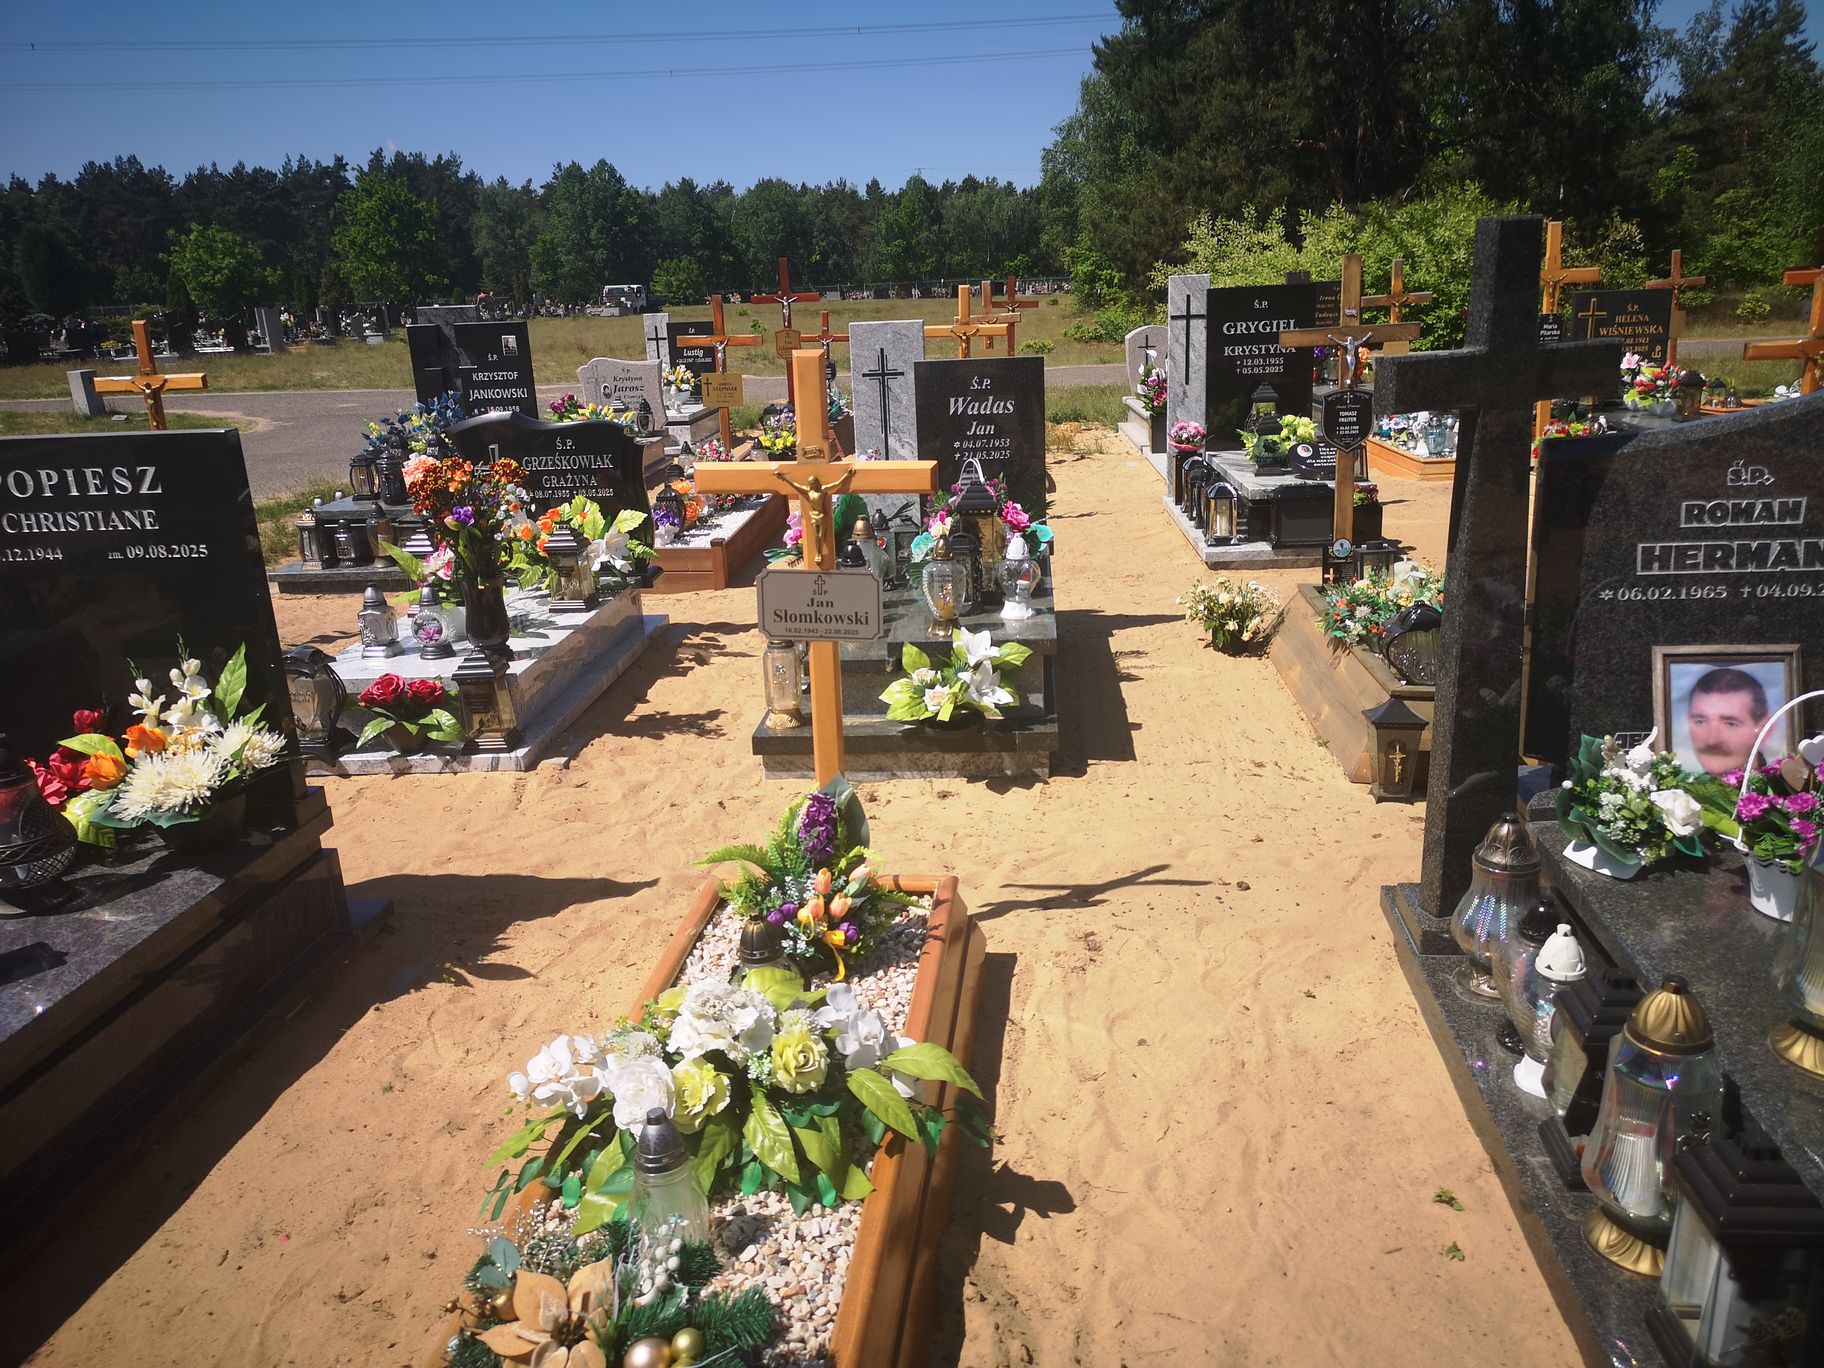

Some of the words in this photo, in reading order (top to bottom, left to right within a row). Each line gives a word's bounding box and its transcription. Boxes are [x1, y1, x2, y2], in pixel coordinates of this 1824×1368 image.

[1253, 299, 1269, 309] Ś.P.
[1615, 315, 1649, 323] HELENA
[1222, 319, 1299, 335] GRYGIEL
[1599, 323, 1663, 336] WIŚNIEWSKA
[683, 348, 704, 357] Lustig
[1242, 357, 1284, 366] 12.03.1955
[472, 371, 519, 381] KRZYSZTOF
[970, 376, 991, 390] Ś.P.
[469, 387, 529, 402] JANKOWSKI
[613, 384, 645, 394] Jarosz
[949, 396, 1015, 416] Wadas
[966, 421, 995, 436] Jan
[556, 437, 576, 450] Ś.P.
[962, 438, 1010, 448] 04.07.1953
[522, 452, 614, 471] GRZEŚKOWIAK
[0, 466, 163, 498] OPIESZ
[542, 473, 598, 487] GRAŻYNA
[1680, 497, 1808, 528] ROMAN
[1, 509, 160, 534] CHRISTIANE
[108, 551, 124, 560] zm.
[126, 544, 209, 559] 09.08.2025
[1617, 586, 1728, 601] 06.02.1965
[806, 598, 834, 608] Jan
[773, 609, 869, 625] Słomkowski
